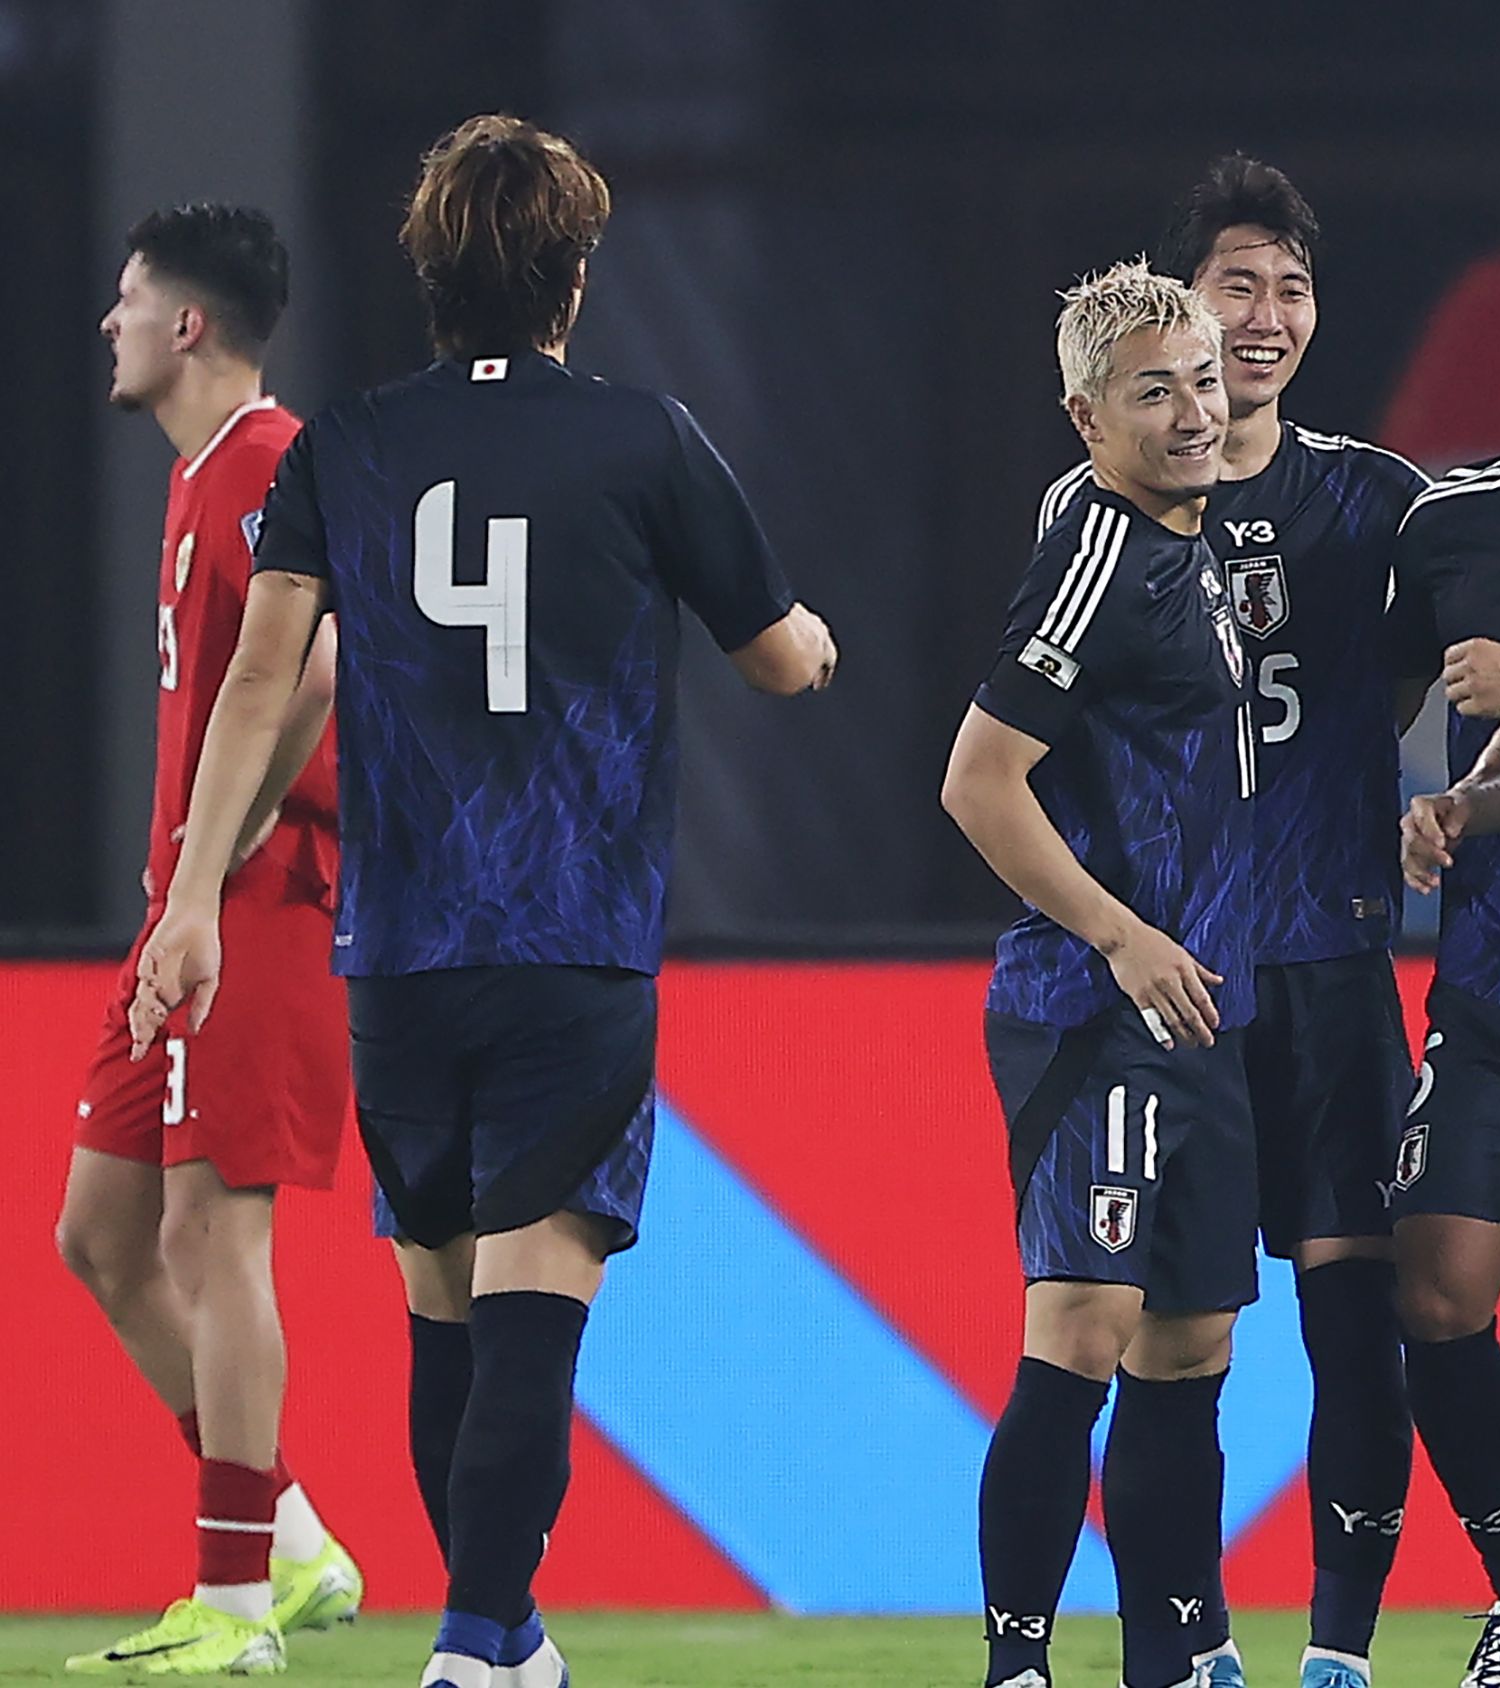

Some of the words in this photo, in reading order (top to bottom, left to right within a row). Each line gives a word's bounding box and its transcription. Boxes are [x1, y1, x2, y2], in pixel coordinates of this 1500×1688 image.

[1223, 520, 1276, 547] Y-3
[413, 480, 529, 712] 4
[1107, 1085, 1159, 1181] 11
[1329, 1501, 1405, 1536] Y-3
[989, 1605, 1046, 1640] Y-3
